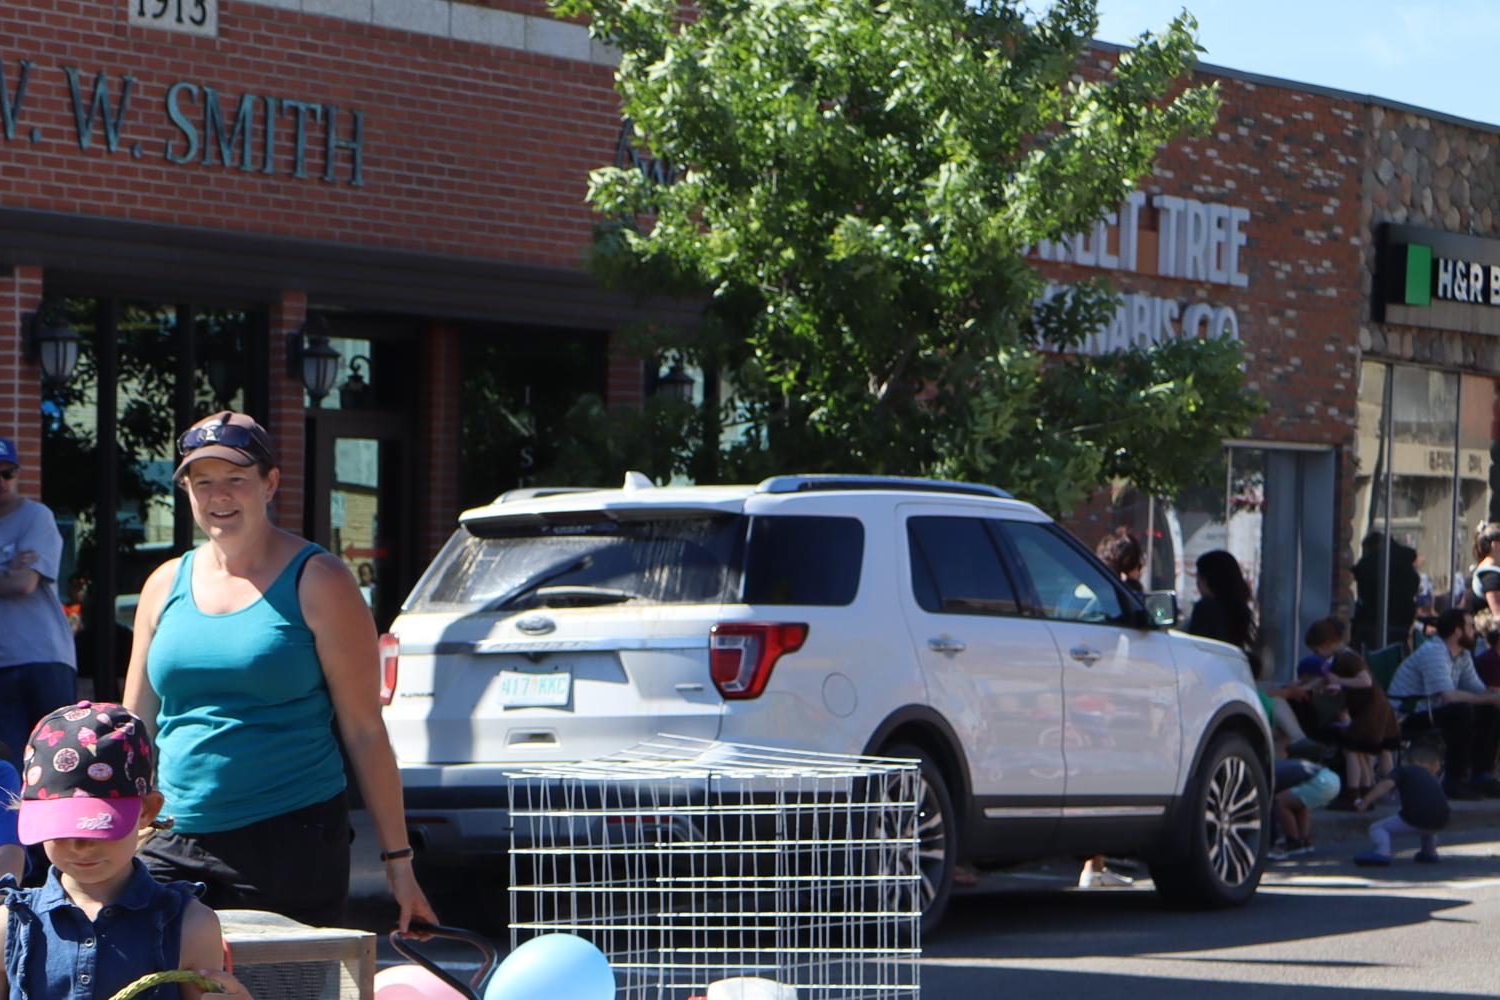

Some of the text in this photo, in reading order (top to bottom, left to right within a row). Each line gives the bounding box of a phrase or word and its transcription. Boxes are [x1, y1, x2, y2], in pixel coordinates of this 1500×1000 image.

[64, 65, 143, 159] W.
[164, 82, 365, 187] SMITH
[1153, 194, 1250, 288] TREE
[1438, 257, 1484, 303] H&R
